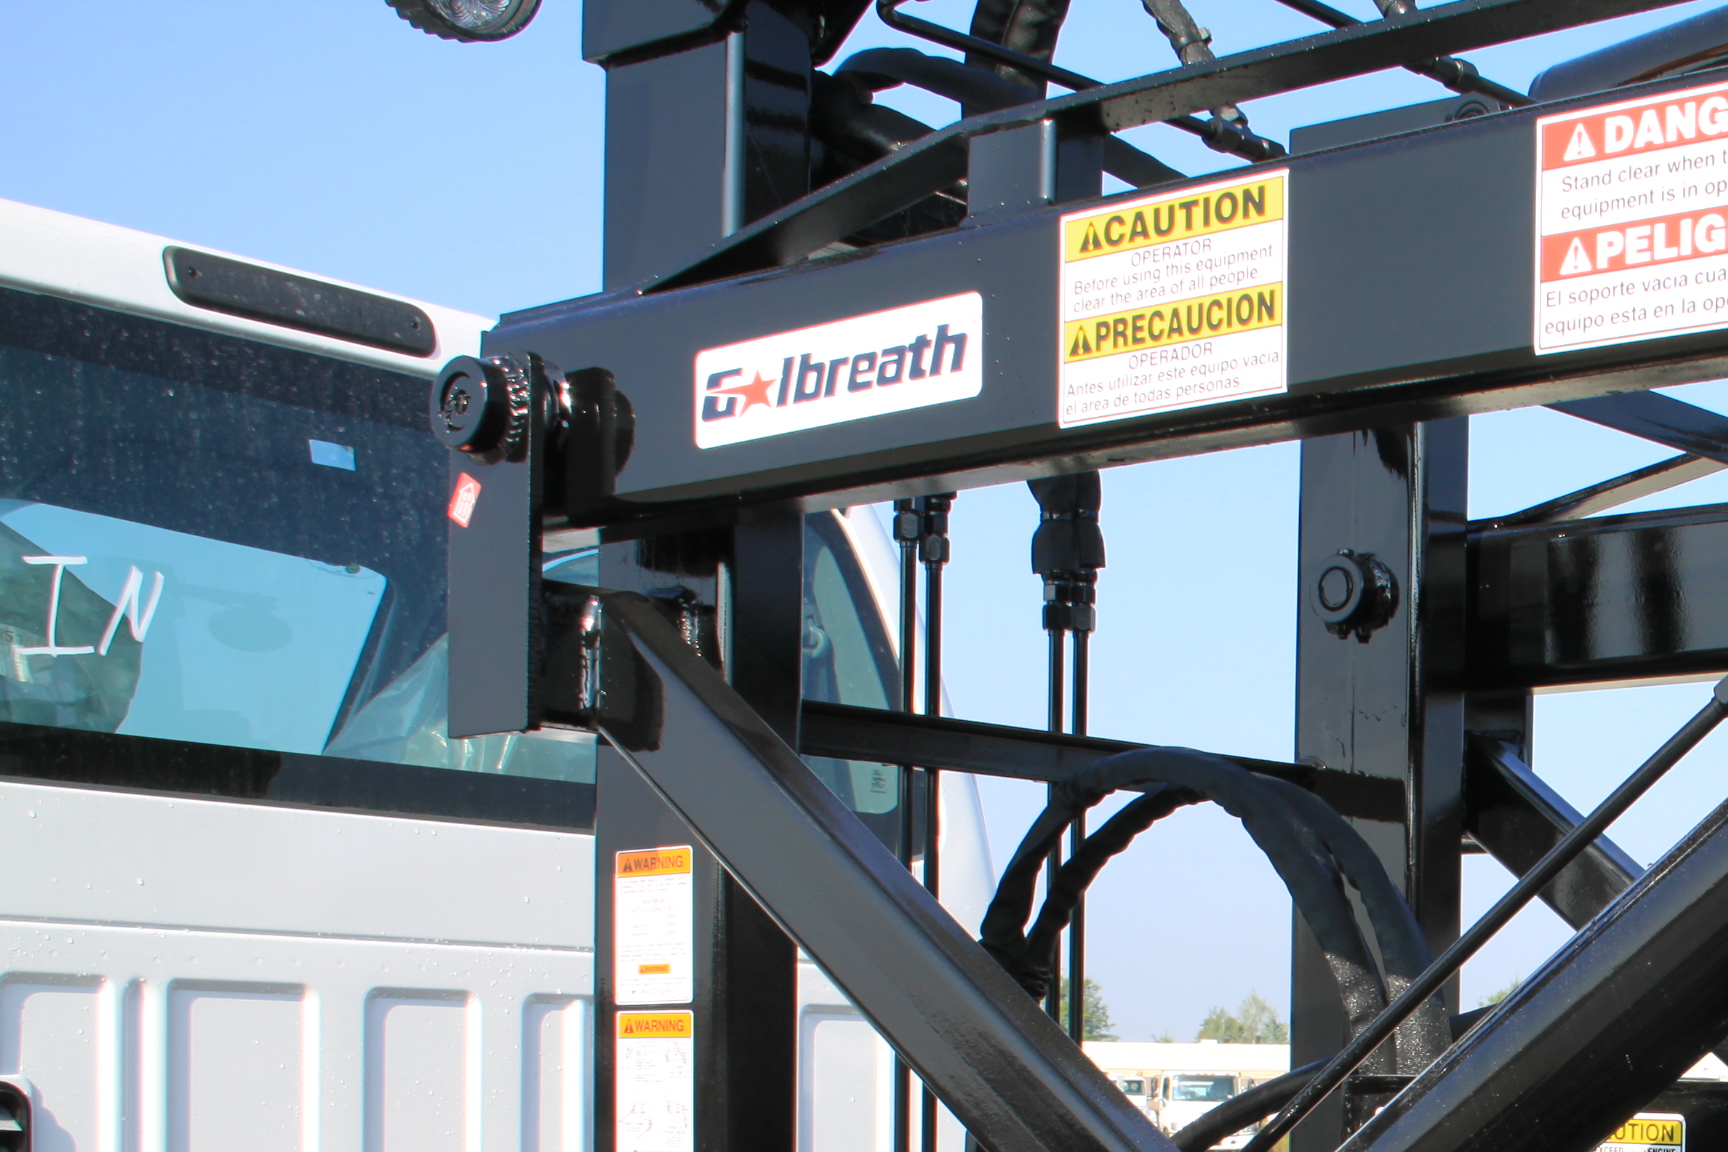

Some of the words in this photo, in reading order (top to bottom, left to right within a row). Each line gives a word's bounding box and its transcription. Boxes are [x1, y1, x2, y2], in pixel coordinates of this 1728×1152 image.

[1561, 168, 1612, 193] Stand
[1618, 160, 1660, 183] clear
[1667, 150, 1715, 174] when
[1103, 185, 1266, 248] CAUTION
[1560, 188, 1654, 223] equipment
[1661, 184, 1675, 202] is
[1683, 180, 1697, 198] in
[1073, 273, 1118, 295] Before
[1123, 267, 1160, 289] using
[1166, 259, 1191, 277] this
[1196, 243, 1272, 274] equipment
[1131, 237, 1211, 267] OPERATOR
[1073, 294, 1105, 313] clear
[1111, 289, 1131, 306] the
[1136, 285, 1165, 301] area
[1170, 279, 1183, 294] of
[1188, 275, 1203, 291] all
[1209, 264, 1261, 290] people.
[1546, 289, 1561, 307] El
[1568, 279, 1635, 308] soporte
[1095, 289, 1275, 352] PRECAUCION
[1544, 310, 1604, 338] equipo
[1653, 303, 1674, 318] en
[1682, 297, 1696, 314] la
[1128, 341, 1212, 370] OPERADOR
[1065, 401, 1076, 415] el
[1081, 398, 1108, 413] area
[1114, 393, 1128, 407] de
[1134, 386, 1170, 404] todas
[1176, 375, 1243, 400] personas.
[1067, 379, 1103, 397] Antes
[1108, 370, 1152, 390] utilizar
[1157, 365, 1185, 382] este
[1190, 356, 1237, 380] equipo
[21, 556, 165, 657] IN
[633, 855, 683, 870] WARNING
[634, 1019, 685, 1032] WARNING
